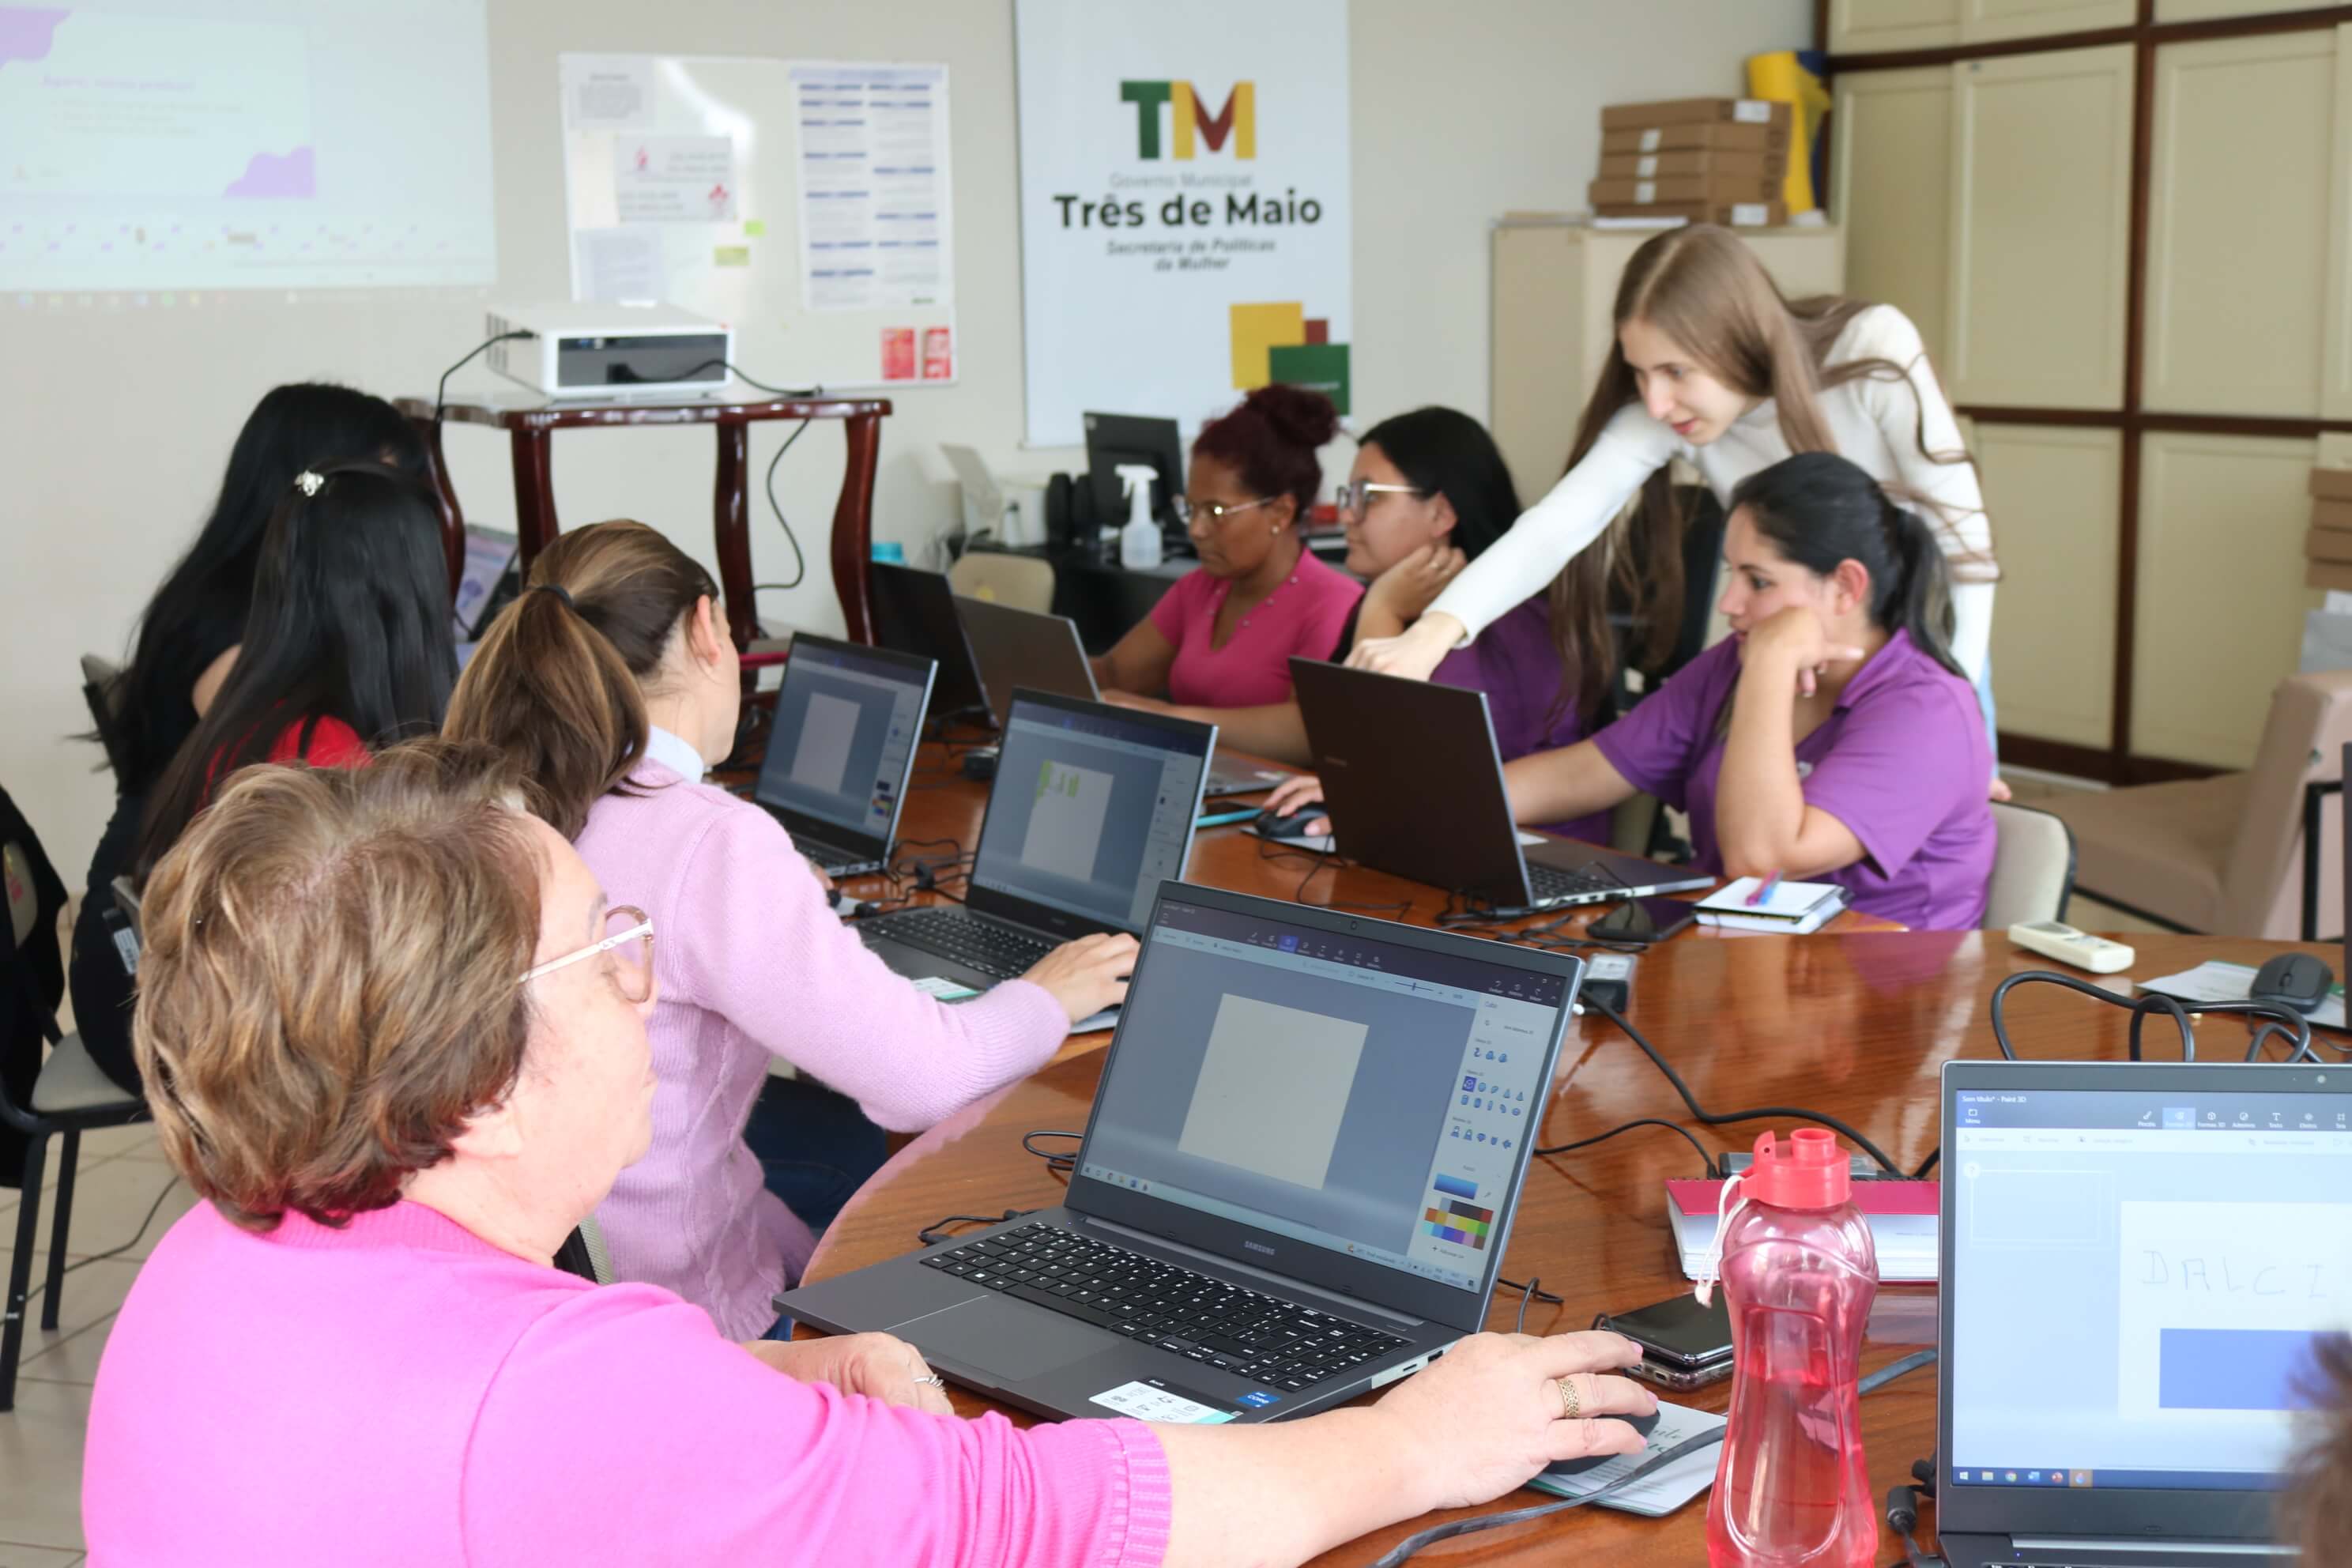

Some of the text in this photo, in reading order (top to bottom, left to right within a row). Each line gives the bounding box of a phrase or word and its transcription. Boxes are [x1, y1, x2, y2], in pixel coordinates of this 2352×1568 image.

[1121, 80, 1257, 160] TM
[1054, 188, 1321, 228] Três de Maio
[1245, 1240, 1276, 1256] SAMSUNG
